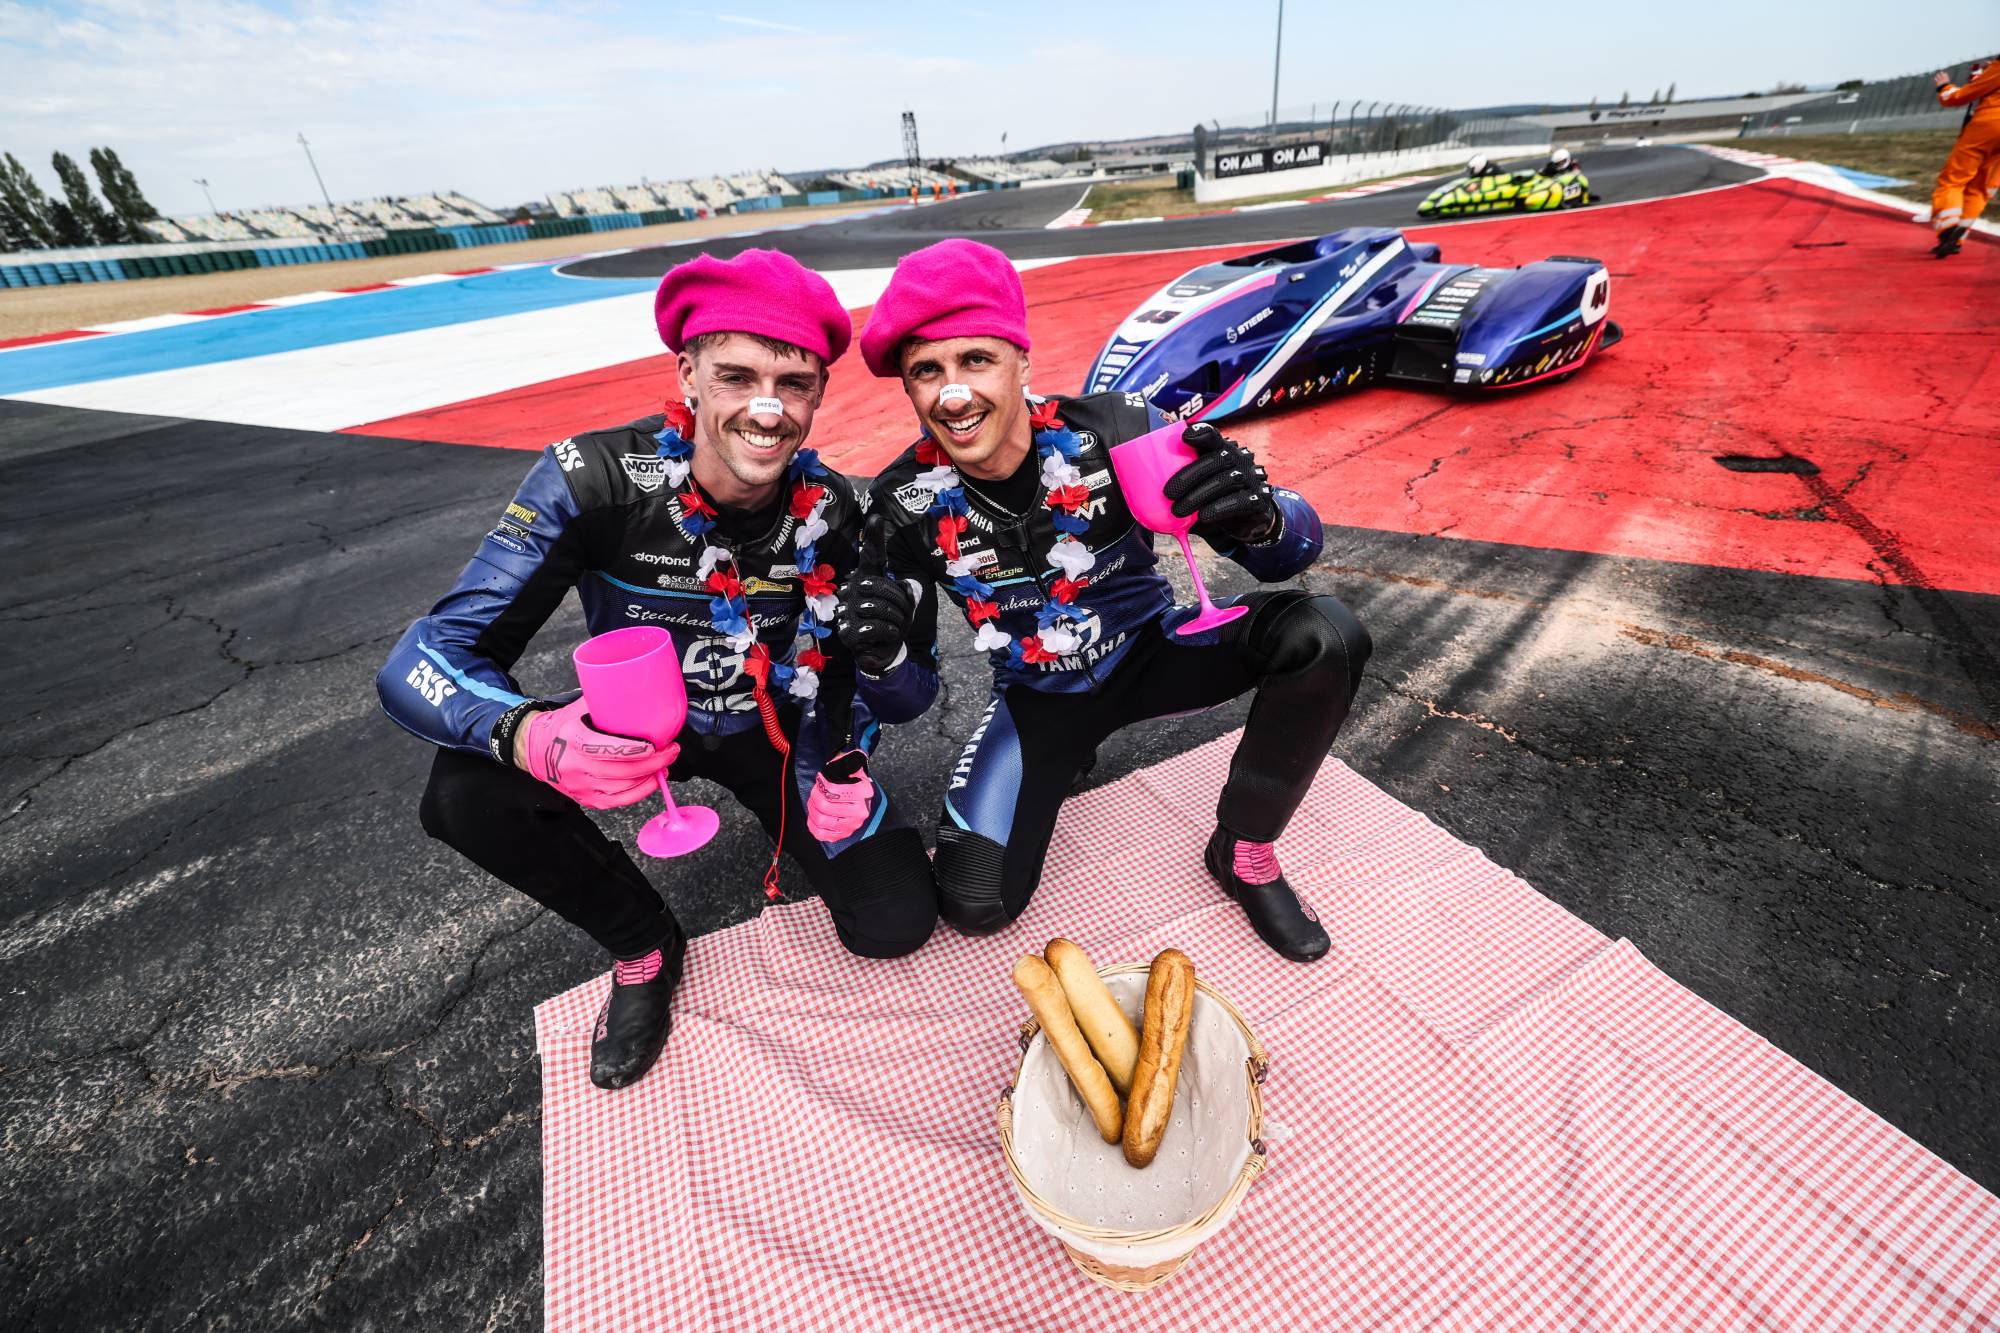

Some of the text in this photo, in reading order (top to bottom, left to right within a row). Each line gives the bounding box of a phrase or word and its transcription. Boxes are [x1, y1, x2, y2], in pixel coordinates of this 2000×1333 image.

[1219, 156, 1239, 171] ON
[1241, 153, 1263, 169] AIR
[1273, 145, 1319, 164] ON AIR
[1237, 306, 1274, 335] STIEBEL
[770, 514, 796, 554] YAMAHA
[630, 552, 691, 567] daytona
[949, 699, 999, 790] YAMAHA
